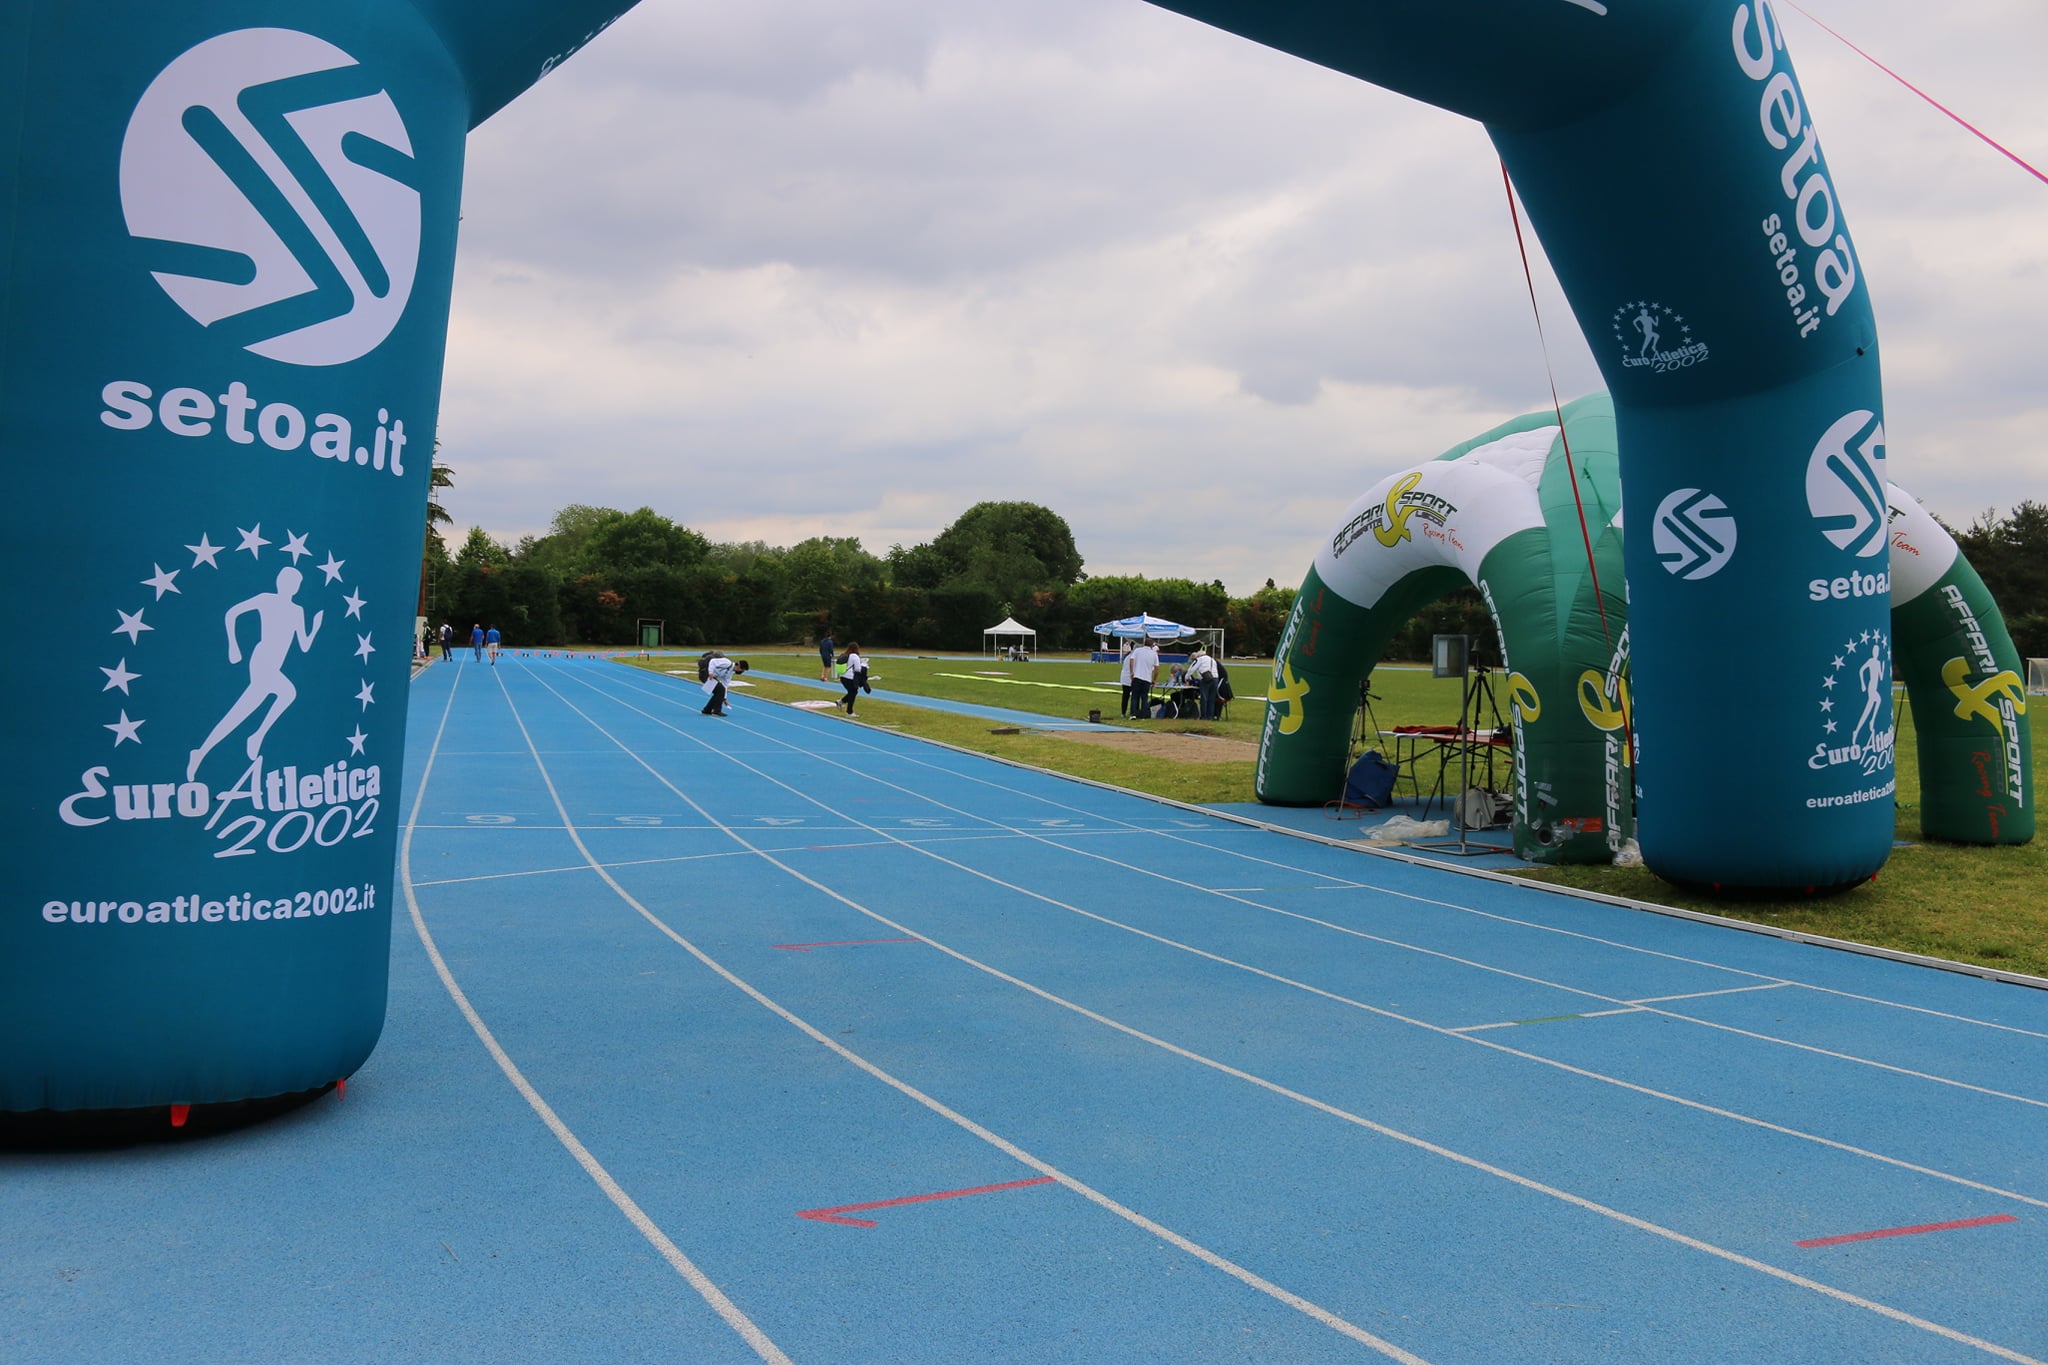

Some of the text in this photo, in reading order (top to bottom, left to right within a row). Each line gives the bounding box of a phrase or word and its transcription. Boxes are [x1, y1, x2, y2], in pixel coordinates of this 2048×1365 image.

[1732, 0, 1856, 317] setoa
[1762, 213, 1822, 339] setoa.it
[1655, 350, 1709, 373] 2002
[100, 380, 407, 477] setoa.it
[1332, 503, 1385, 553] AFFARI
[1399, 491, 1458, 518] SPORT
[1890, 532, 1920, 556] Team
[1808, 563, 1890, 601] setoa.i
[1257, 703, 1278, 796] AFFARI
[1275, 595, 1305, 682] SPORT
[1941, 584, 1999, 674] AFFARI
[1998, 698, 2023, 808] SPORT
[59, 755, 381, 831] EuroAtletica
[1512, 702, 1528, 825] SPORT
[1863, 744, 1895, 777] 200
[213, 798, 380, 859] 2002
[41, 883, 376, 923] euroatletica2002.it
